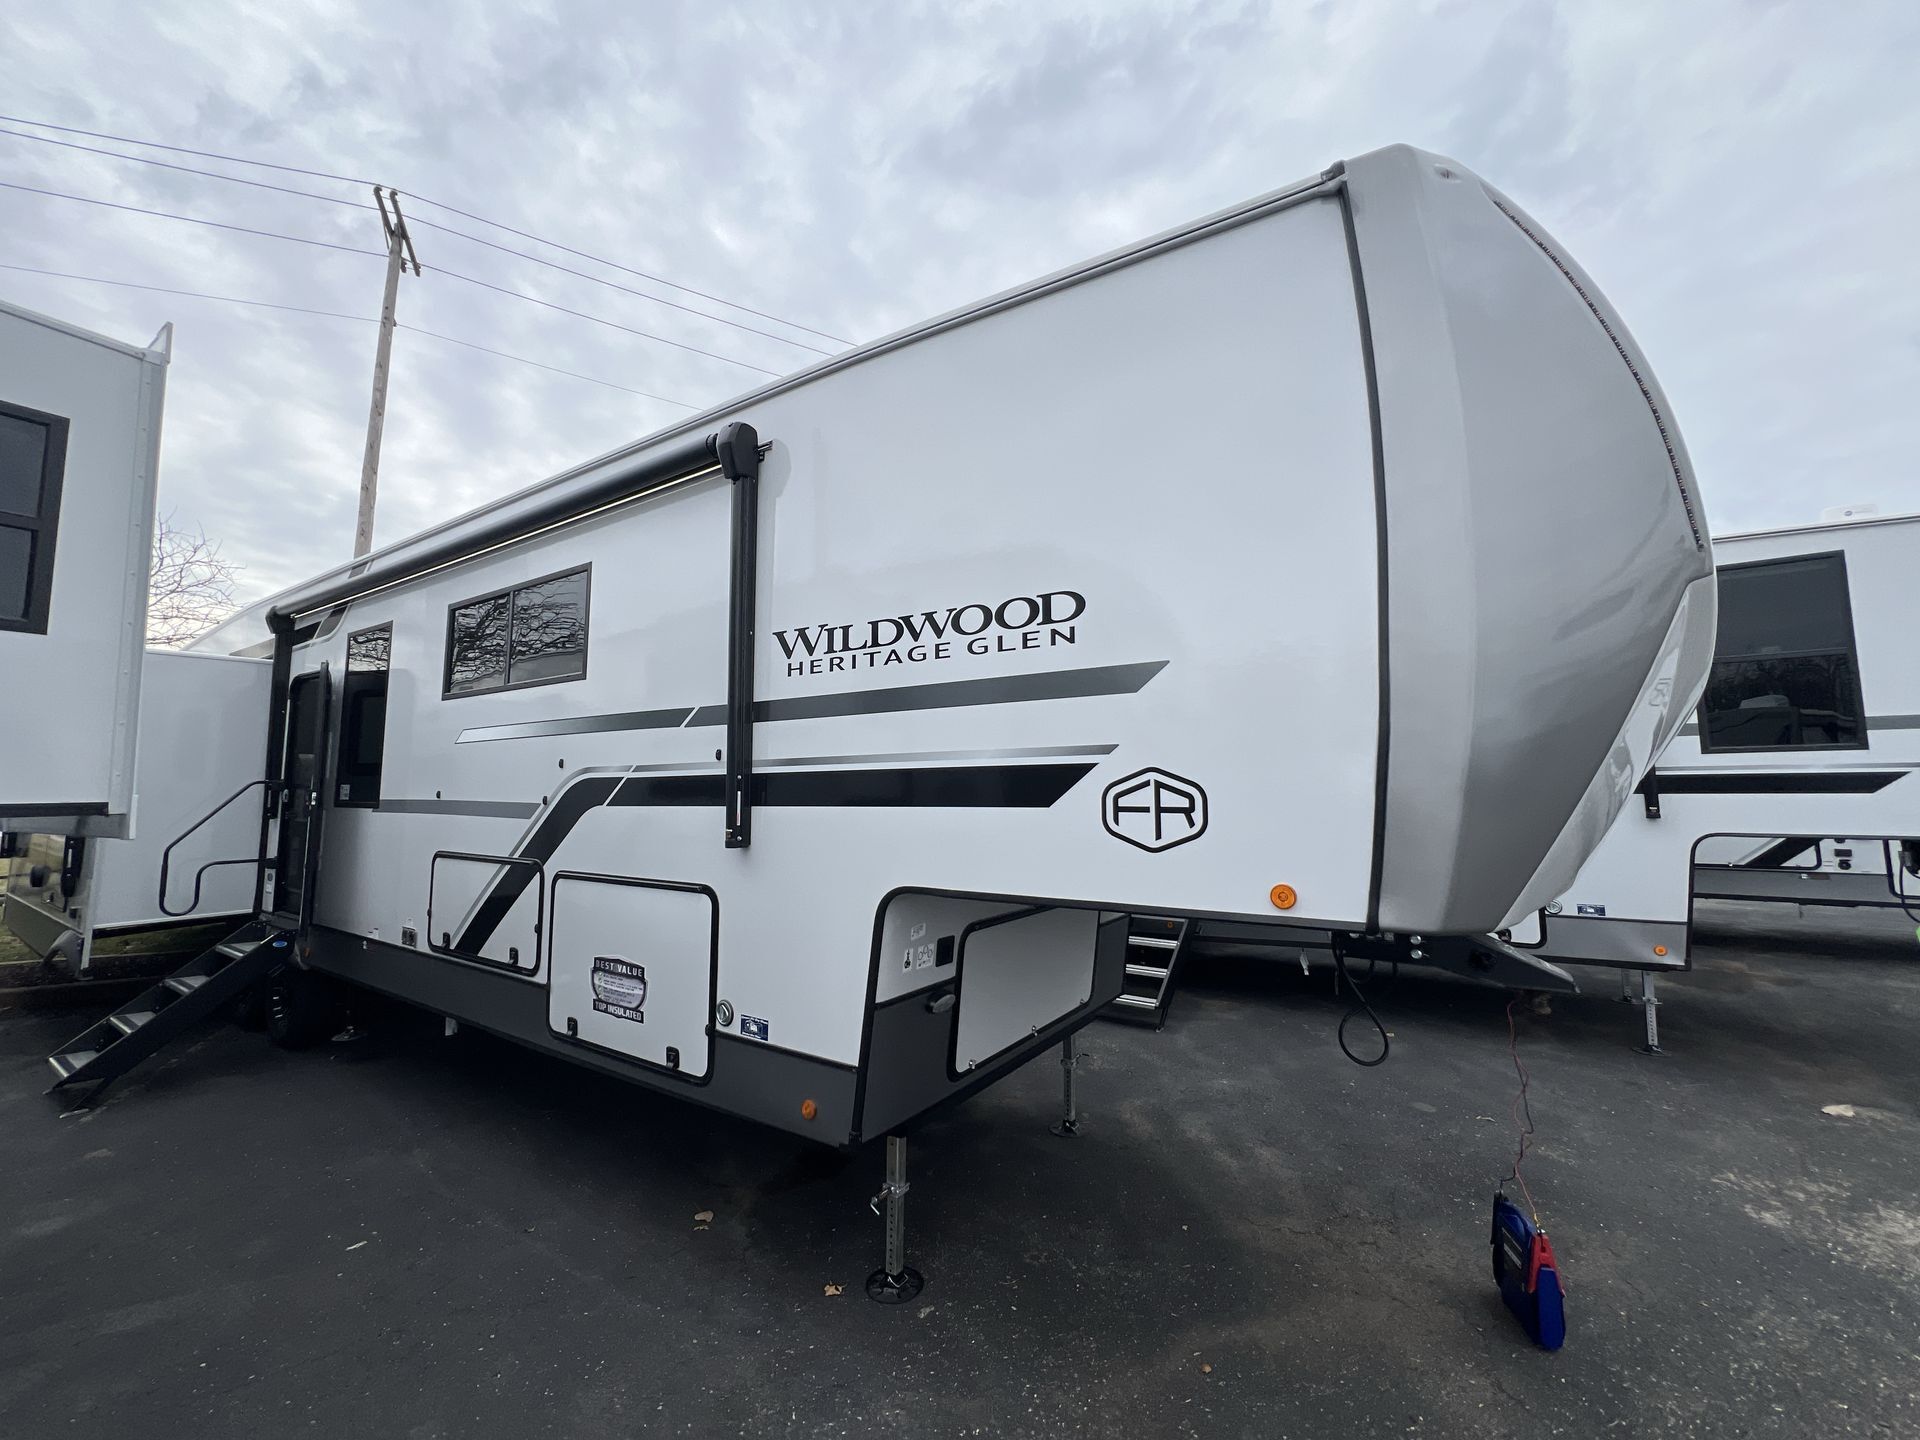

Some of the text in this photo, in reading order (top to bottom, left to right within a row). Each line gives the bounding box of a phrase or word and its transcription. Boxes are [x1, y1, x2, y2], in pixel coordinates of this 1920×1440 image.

[772, 590, 1087, 660] WILDWOOD
[787, 625, 1077, 678] HERITAGE GLEN
[595, 960, 643, 976] BEST VALUE
[595, 1001, 642, 1020] TOP INSULATED
